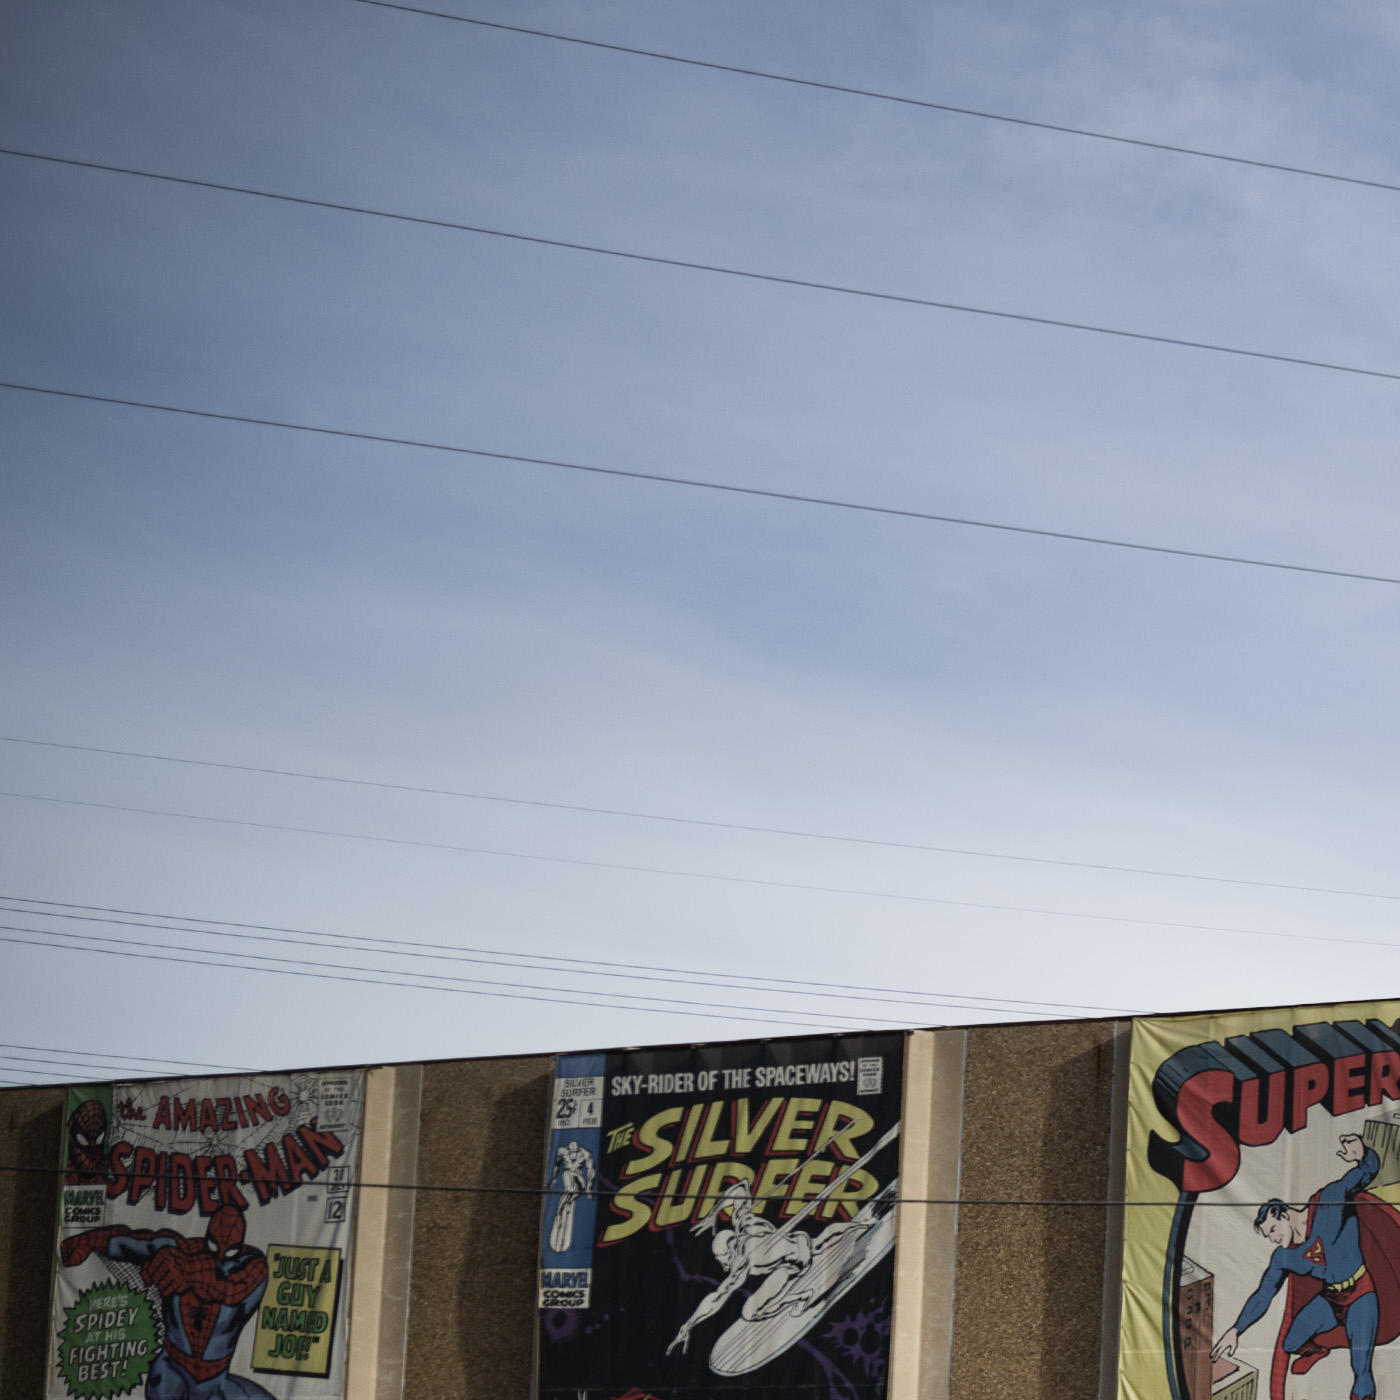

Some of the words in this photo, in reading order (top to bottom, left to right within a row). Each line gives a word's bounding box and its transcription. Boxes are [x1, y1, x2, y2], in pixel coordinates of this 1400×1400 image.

[564, 1078, 593, 1088] SILVER
[611, 1072, 694, 1096] SKY-RIDER
[697, 1070, 719, 1092] OF
[722, 1068, 752, 1090] THE
[755, 1061, 855, 1088] SPACEWAYS!
[561, 1087, 597, 1098] SURFER
[119, 1097, 147, 1121] the
[153, 1087, 290, 1132] AMAZING
[556, 1098, 577, 1119] 25¢
[587, 1101, 593, 1115] 4
[606, 1122, 636, 1154] THE
[622, 1097, 875, 1177] SILVER
[106, 1117, 343, 1217] SPIDER-MAN
[600, 1158, 880, 1244] SURFER
[319, 1259, 332, 1283] A
[90, 1294, 129, 1311] HERE'S
[277, 1281, 320, 1308] GUY
[542, 1298, 585, 1307] GROUP
[74, 1307, 139, 1333] SPIDEY
[85, 1331, 102, 1344] AT
[105, 1328, 126, 1342] HIS
[70, 1339, 147, 1365] FIGHTING
[78, 1359, 129, 1383] BEST!
